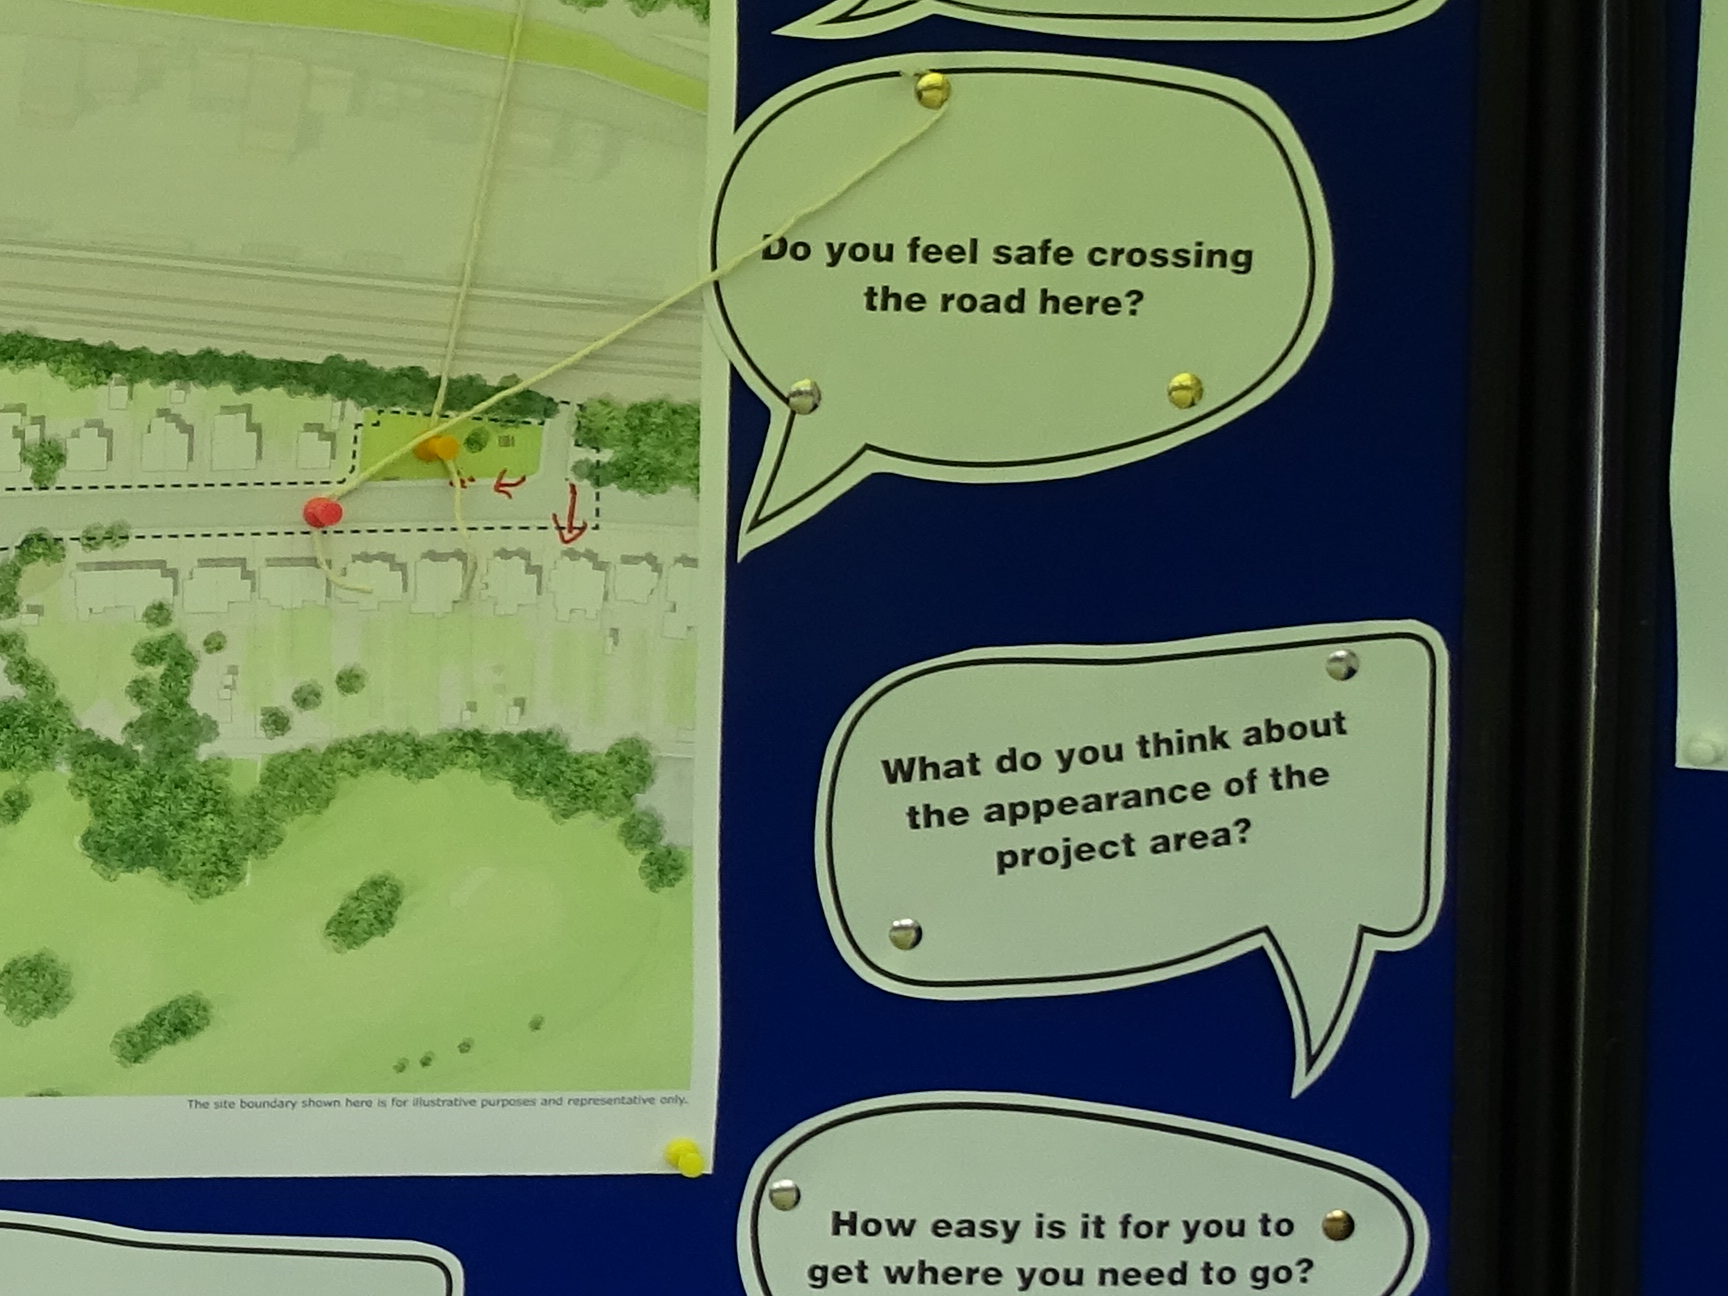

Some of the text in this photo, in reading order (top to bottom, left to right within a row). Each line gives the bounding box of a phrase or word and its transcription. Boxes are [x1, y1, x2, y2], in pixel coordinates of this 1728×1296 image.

[761, 233, 1253, 275] Do you feel safe crossing
[863, 285, 1144, 316] the road here?
[831, 1210, 1295, 1245] How easy is it for you to
[807, 1257, 1314, 1292] get where you need to go?
